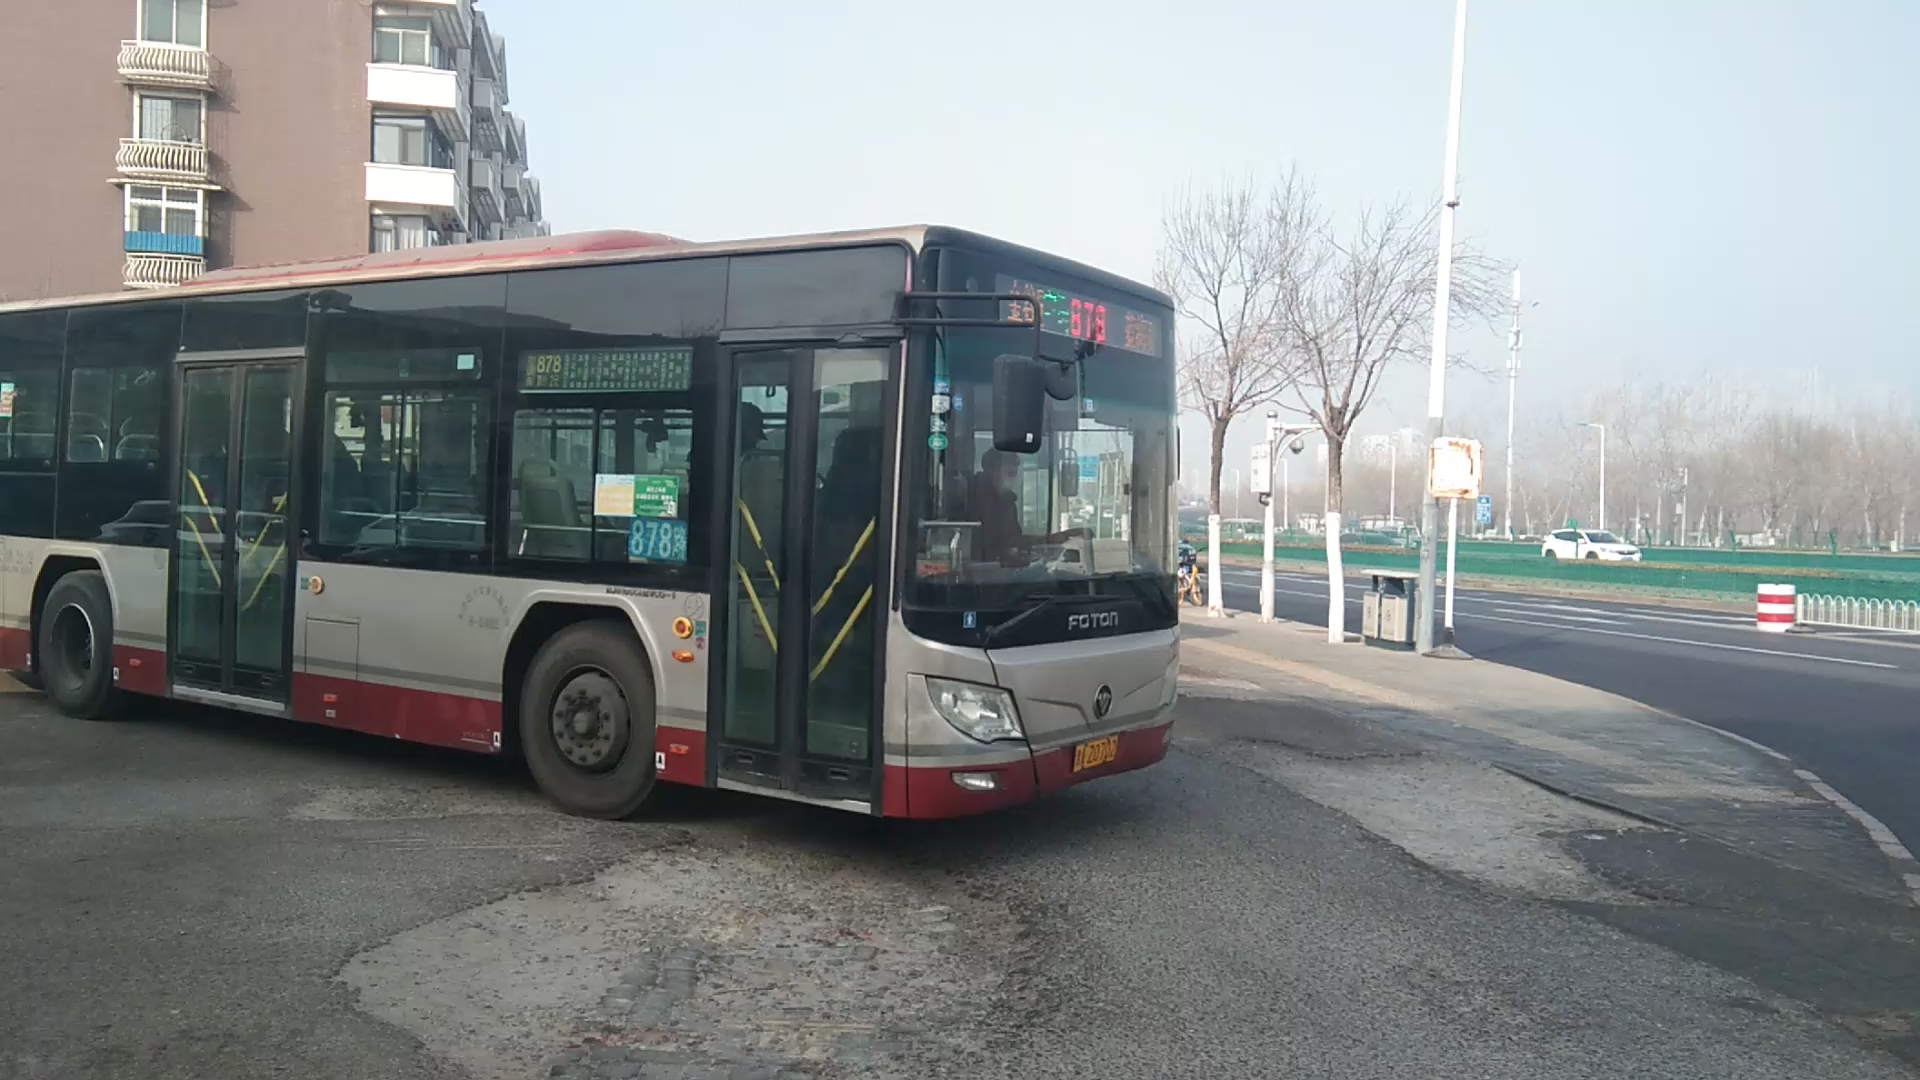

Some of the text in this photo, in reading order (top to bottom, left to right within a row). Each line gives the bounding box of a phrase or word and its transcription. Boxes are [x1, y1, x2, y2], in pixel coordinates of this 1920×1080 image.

[1070, 298, 1106, 343] 878
[536, 355, 562, 374] 878
[1068, 611, 1119, 631] FOTON
